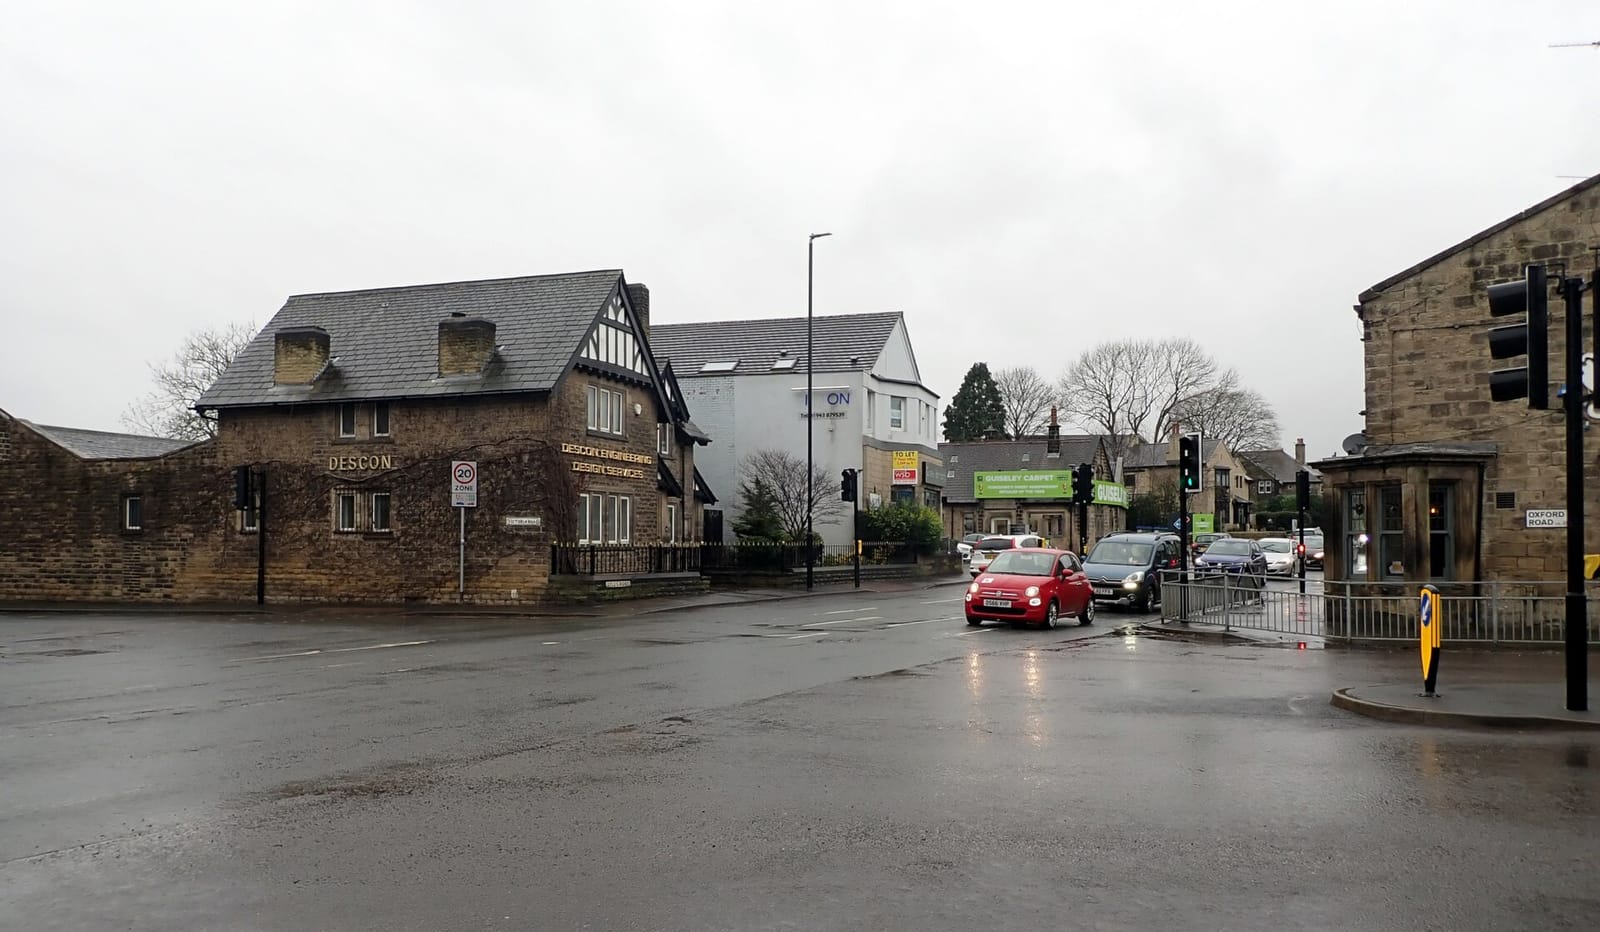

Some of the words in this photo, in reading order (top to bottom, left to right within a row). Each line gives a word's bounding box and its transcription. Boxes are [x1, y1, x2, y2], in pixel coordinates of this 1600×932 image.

[561, 442, 599, 457] DESCON
[600, 448, 652, 465] ENGINEERING
[329, 455, 392, 470] DESCON
[572, 461, 606, 474] DESIGN
[606, 465, 644, 479] SERVICES
[457, 469, 472, 478] 20
[985, 474, 1022, 482] GUISELEY
